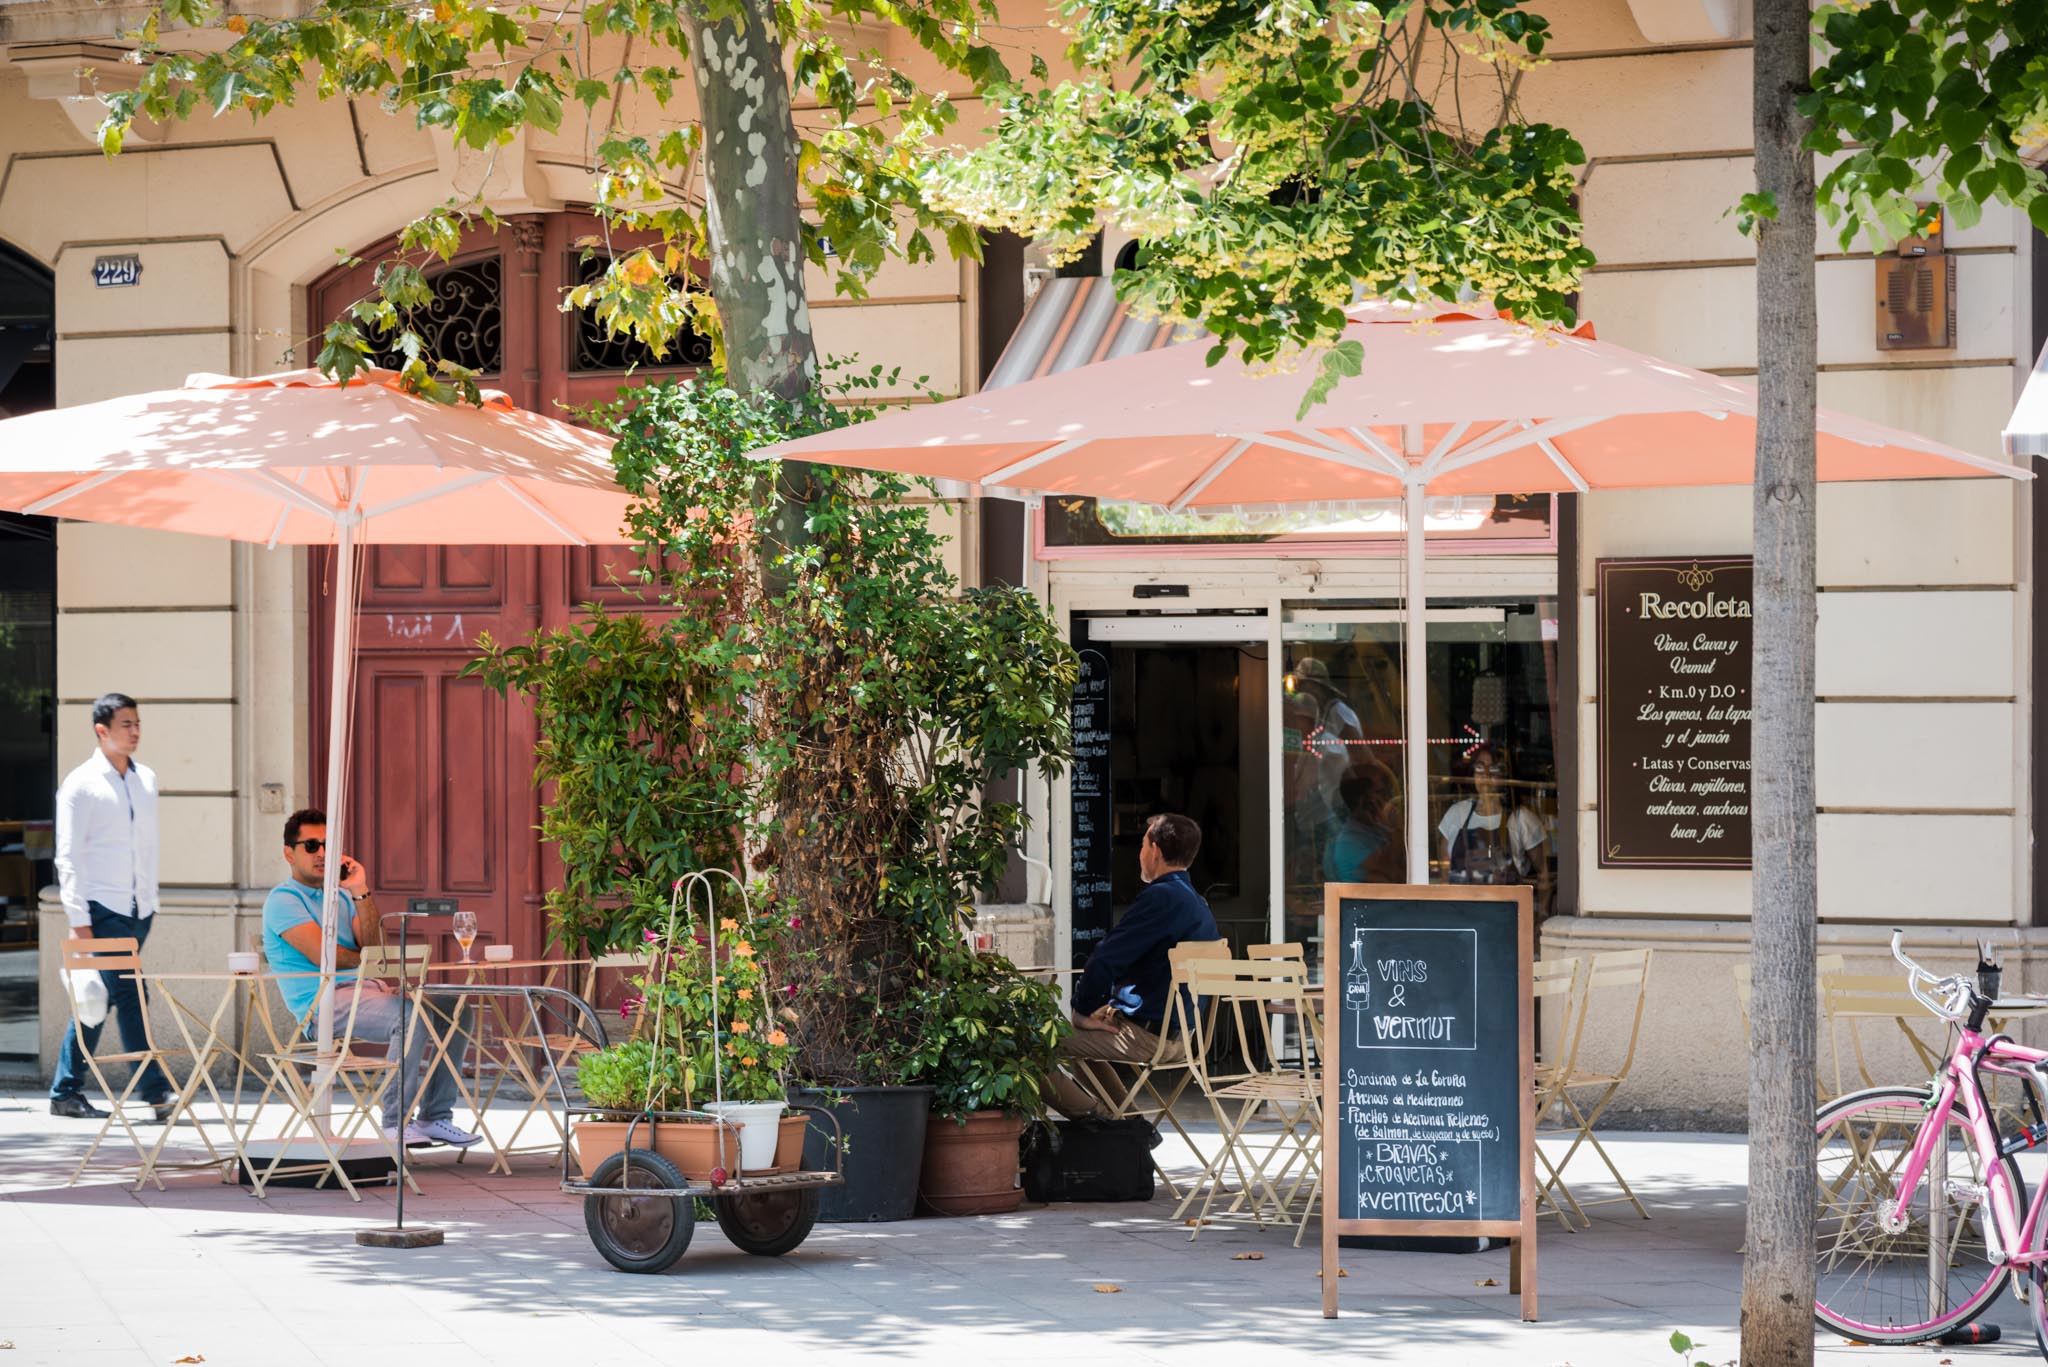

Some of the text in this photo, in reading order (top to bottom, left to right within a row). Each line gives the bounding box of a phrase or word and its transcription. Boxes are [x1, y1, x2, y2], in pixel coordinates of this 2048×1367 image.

[97, 259, 136, 285] 229
[1639, 591, 1752, 619] Recoleta
[1653, 633, 1739, 655] Vinos, Cavas y
[1670, 656, 1717, 674] Vermut
[1698, 688, 1707, 702] y
[1710, 684, 1736, 698] D.O
[1637, 702, 1753, 726] Los quesos, las tapa
[1661, 728, 1730, 748] y el jamón
[1642, 756, 1752, 773] Latas y Conservas
[1649, 774, 1747, 796] Olivas, mejillones,
[1702, 800, 1749, 816] anchoas
[1670, 823, 1725, 843] buen foie
[1377, 959, 1428, 983] VINS
[1348, 984, 1366, 994] CAVA
[1388, 984, 1406, 1008] &
[1347, 1068, 1397, 1088] Sardinas
[1401, 1073, 1413, 1085] de
[1347, 1088, 1464, 1107] Anchoas del Mediterraneo
[1391, 1112, 1402, 1124] de
[1461, 1129, 1471, 1139] de
[1376, 1143, 1438, 1165] BRAVAS
